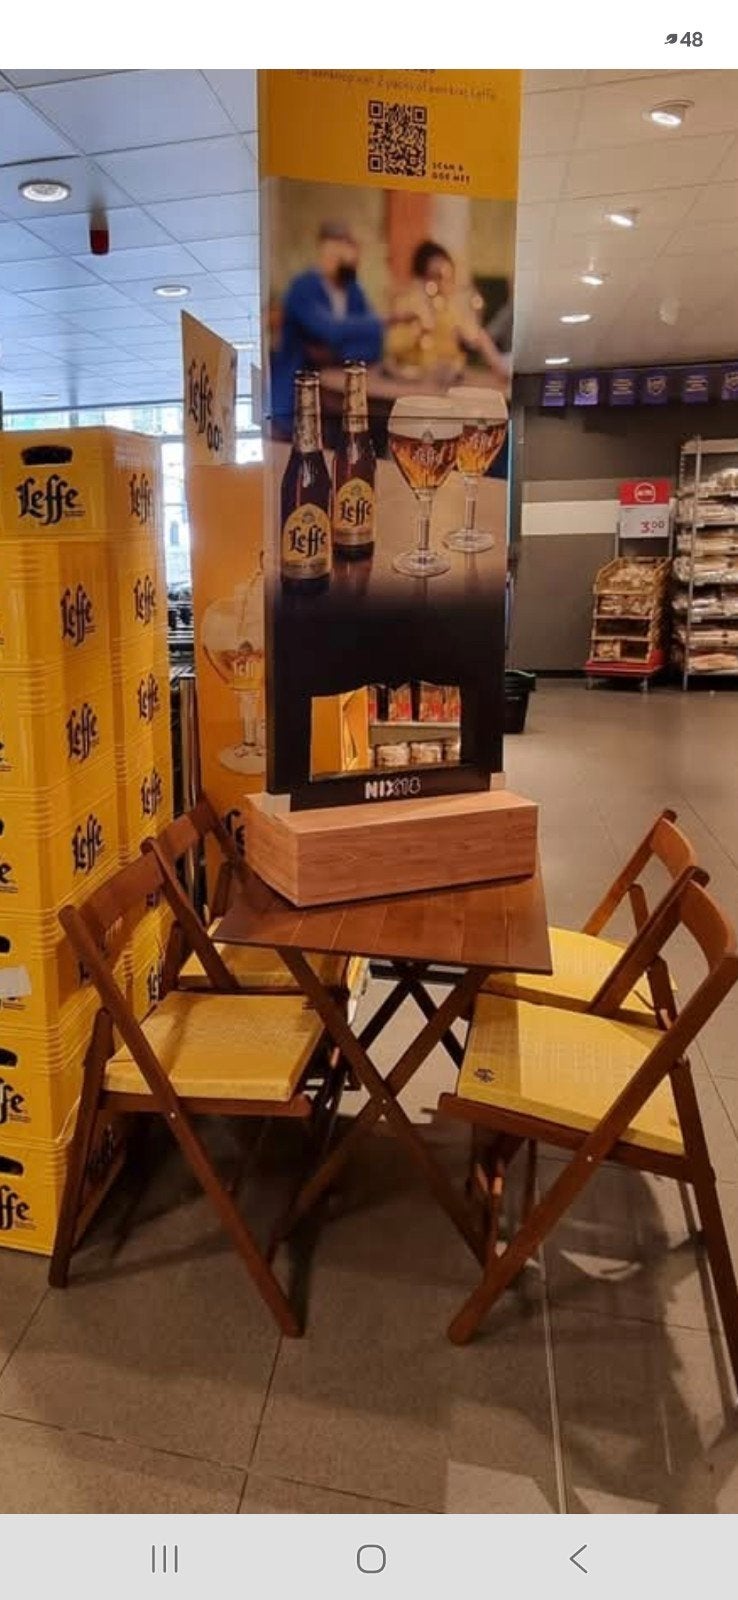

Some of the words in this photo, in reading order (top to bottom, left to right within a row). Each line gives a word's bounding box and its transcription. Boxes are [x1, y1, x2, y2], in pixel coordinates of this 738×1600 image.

[188, 359, 213, 434] Leffe
[16, 473, 79, 526] Leffe
[129, 472, 153, 525] Leffe
[340, 497, 373, 526] Leffe
[289, 525, 327, 557] Leffe
[61, 583, 92, 646] Leffe
[133, 574, 156, 626] Leffe
[137, 673, 160, 724] Leffe
[66, 702, 98, 763] Leffe
[141, 767, 162, 820] Leffe
[72, 813, 103, 876] Leffe
